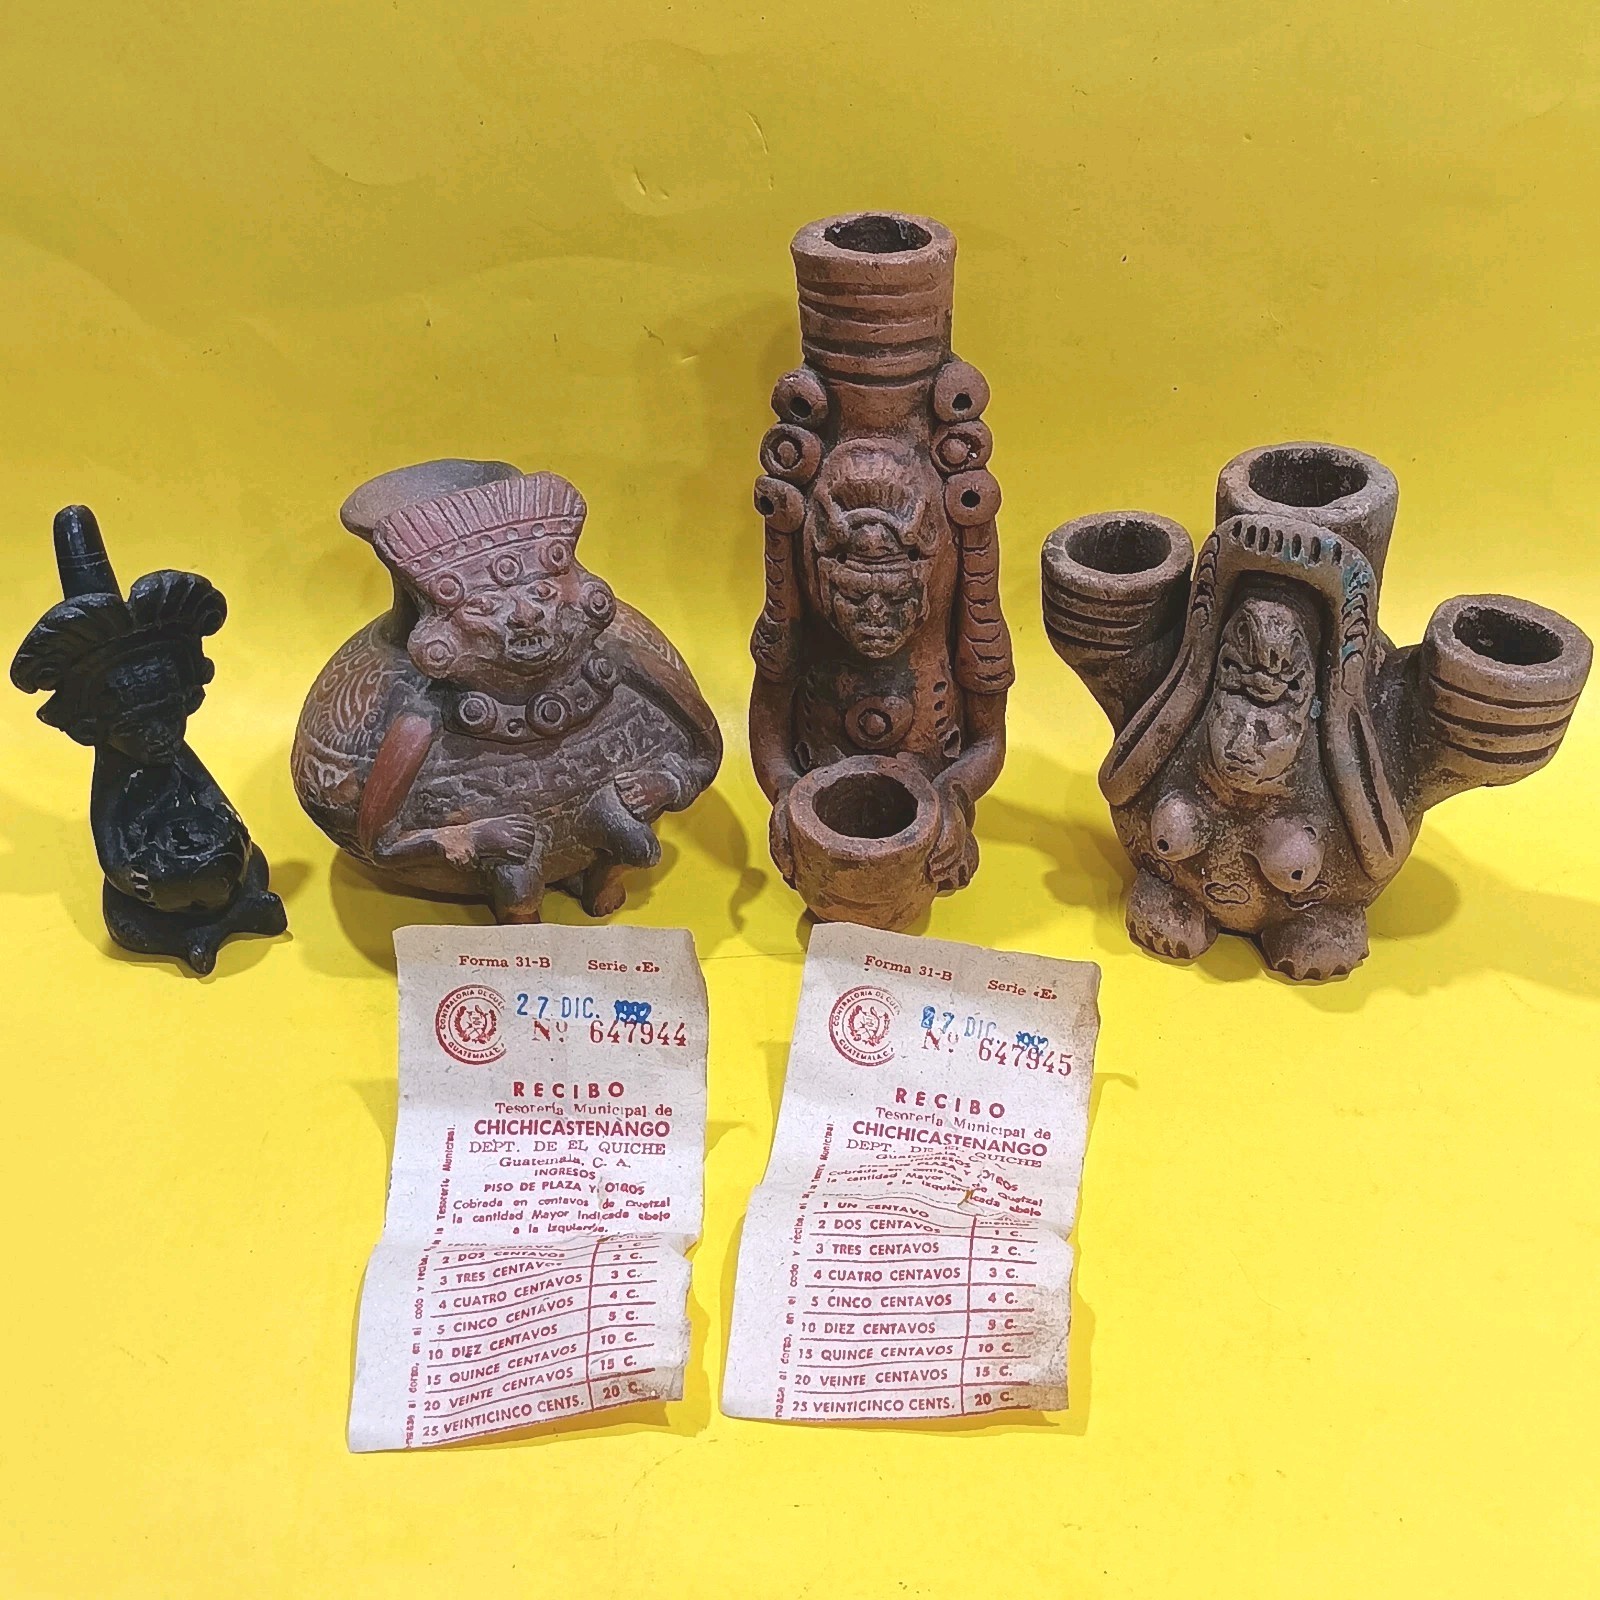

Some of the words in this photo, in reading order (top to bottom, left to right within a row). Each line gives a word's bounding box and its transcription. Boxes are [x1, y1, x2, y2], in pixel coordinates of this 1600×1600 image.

[459, 956, 509, 967] Forma
[516, 956, 550, 968] 31-B
[587, 960, 627, 973] Serie
[864, 955, 911, 974] Forma
[919, 966, 952, 981] 31-B
[988, 980, 1026, 995] Serie
[439, 989, 475, 1030] CONTRALORIA
[561, 997, 601, 1018] DIC.
[590, 1019, 686, 1047] 647944
[977, 1037, 1073, 1076] 647945
[514, 1082, 624, 1099] RECIBO
[495, 1102, 563, 1115] Tesorería
[574, 1103, 646, 1118] Municipal
[655, 1104, 672, 1116] de
[895, 1087, 1005, 1119] RECIBO
[474, 1118, 670, 1138] CHICHICASTENANGO
[953, 1117, 1025, 1139] Municipal
[1034, 1128, 1051, 1140] de
[469, 1139, 520, 1153] DEPT.
[533, 1141, 557, 1152] DE
[568, 1140, 588, 1152] EL
[598, 1141, 665, 1155] QUICHE
[852, 1120, 1048, 1158] CHICHICASTENANGO
[593, 1157, 607, 1168] C.
[616, 1158, 631, 1168] A.
[846, 1138, 894, 1152] DEPT.
[974, 1151, 1043, 1169] QUICHE
[534, 1167, 597, 1181] INGRESOS
[846, 1172, 897, 1181] cantidad
[905, 1172, 943, 1181] Mayor
[484, 1183, 513, 1192] PISO
[520, 1182, 536, 1191] DE
[542, 1181, 581, 1191] PLAZA
[538, 1196, 589, 1207] centavos
[601, 1198, 615, 1209] de
[626, 1197, 670, 1209] Quetzal
[865, 1204, 930, 1218] CENTAVO
[453, 1213, 462, 1224] la
[473, 1210, 523, 1222] cantidad
[531, 1210, 569, 1221] Mayor
[638, 1211, 670, 1222] abajo
[818, 1220, 826, 1229] 2
[834, 1219, 861, 1230] DOS
[870, 1218, 941, 1234] CENTAVOS
[529, 1224, 538, 1233] la
[442, 1256, 450, 1264] 2
[458, 1251, 485, 1261] DOS
[494, 1250, 566, 1259] CENTAVOS
[816, 1243, 823, 1254] 3
[832, 1244, 861, 1255] TRES
[869, 1242, 939, 1255] CENTAVOS
[991, 1245, 999, 1254] 2
[1008, 1246, 1021, 1256] C.
[440, 1276, 447, 1285] 3
[456, 1272, 485, 1283] TRES
[611, 1270, 618, 1279] 3
[627, 1269, 641, 1278] C.
[814, 1270, 822, 1279] 4
[828, 1270, 882, 1282] CUATRO
[890, 1267, 960, 1281] CENTAVOS
[989, 1267, 997, 1278] 3
[1005, 1268, 1018, 1278] C.
[439, 1300, 446, 1309] 4
[452, 1290, 508, 1309] CUATRO
[513, 1272, 584, 1299] CENTAVOS
[609, 1291, 617, 1299] 4
[626, 1289, 639, 1299] C.
[811, 1296, 818, 1307] 5
[827, 1296, 872, 1308] CINCO
[881, 1294, 952, 1307] CENTAVOS
[988, 1293, 996, 1303] 4
[1005, 1292, 1018, 1304] C.
[414, 1298, 424, 1319] codo
[437, 1324, 445, 1335] 5
[453, 1315, 498, 1334] CINCO
[505, 1295, 575, 1324] CENTAVOS
[608, 1311, 616, 1321] 5
[625, 1311, 638, 1321] C.
[802, 1322, 816, 1333] 10
[824, 1322, 855, 1334] DIEZ
[863, 1322, 935, 1335] CENTAVOS
[988, 1319, 996, 1330] 5
[1004, 1319, 1017, 1329] C.
[429, 1349, 443, 1360] 10
[452, 1344, 483, 1359] DIEZ
[488, 1322, 559, 1352] CENTAVOS
[601, 1334, 616, 1345] 10
[625, 1332, 637, 1342] C.
[799, 1349, 813, 1359] 15
[821, 1348, 873, 1361] QUINCE
[881, 1345, 953, 1357] CENTAVOS
[979, 1343, 994, 1353] 10
[1002, 1342, 1014, 1352] C.
[427, 1374, 441, 1385] 15
[449, 1362, 501, 1385] QUINCE
[506, 1342, 578, 1370] CENTAVOS
[599, 1357, 614, 1370] 15
[624, 1355, 636, 1366] C.
[795, 1374, 811, 1385] 20
[820, 1374, 866, 1388] VEINTE
[875, 1369, 947, 1383] CENTAVOS
[976, 1366, 990, 1377] 15
[999, 1365, 1012, 1376] C.
[424, 1400, 440, 1411] 20
[448, 1388, 495, 1410] VEINTE
[501, 1366, 574, 1393] CENTAVOS
[603, 1384, 620, 1399] 20
[628, 1379, 643, 1395] C.
[793, 1401, 807, 1412] 25
[813, 1400, 904, 1413] VEINTICINCO
[909, 1397, 954, 1410] CENTS.
[974, 1393, 992, 1406] 20
[1000, 1390, 1014, 1402] C.
[423, 1426, 438, 1436] 25
[442, 1403, 533, 1435] VEINTICINCO
[537, 1395, 584, 1414] CENTS.
